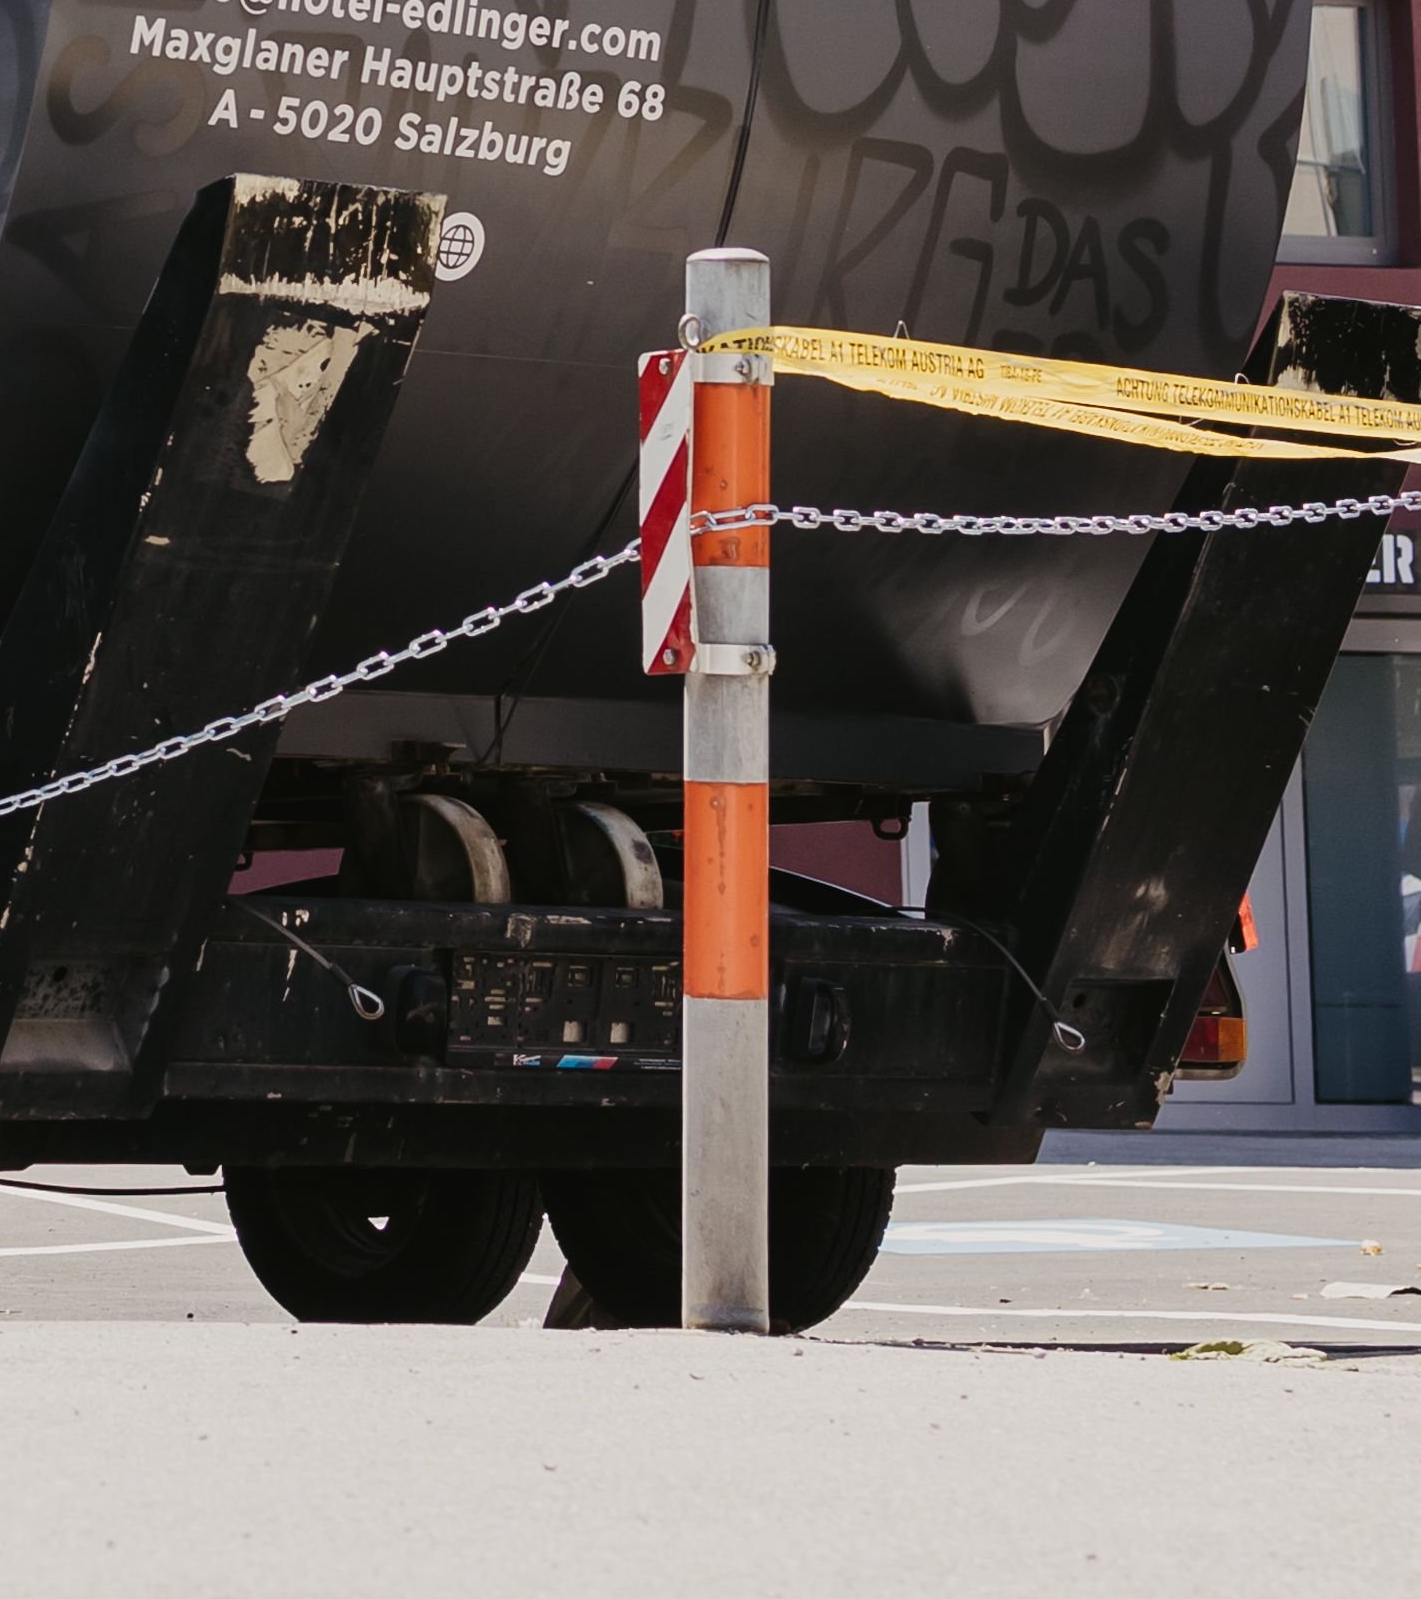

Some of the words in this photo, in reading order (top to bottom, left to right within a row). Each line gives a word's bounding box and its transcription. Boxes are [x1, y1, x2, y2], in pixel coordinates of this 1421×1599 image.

[129, 15, 350, 75] Maxglaner
[360, 45, 605, 114] Hauptstraße
[617, 80, 666, 122] 68
[207, 88, 239, 129] A
[273, 95, 383, 146] 5020
[394, 112, 572, 177] Salzburg
[1001, 196, 1172, 348] DAS
[849, 341, 908, 371] TELEKOM
[911, 348, 965, 378] AUSTRIA
[967, 357, 986, 380] AG
[1115, 376, 1170, 404] ACHTUNG
[1353, 404, 1405, 430] TELEKOM
[1365, 533, 1415, 584] R
